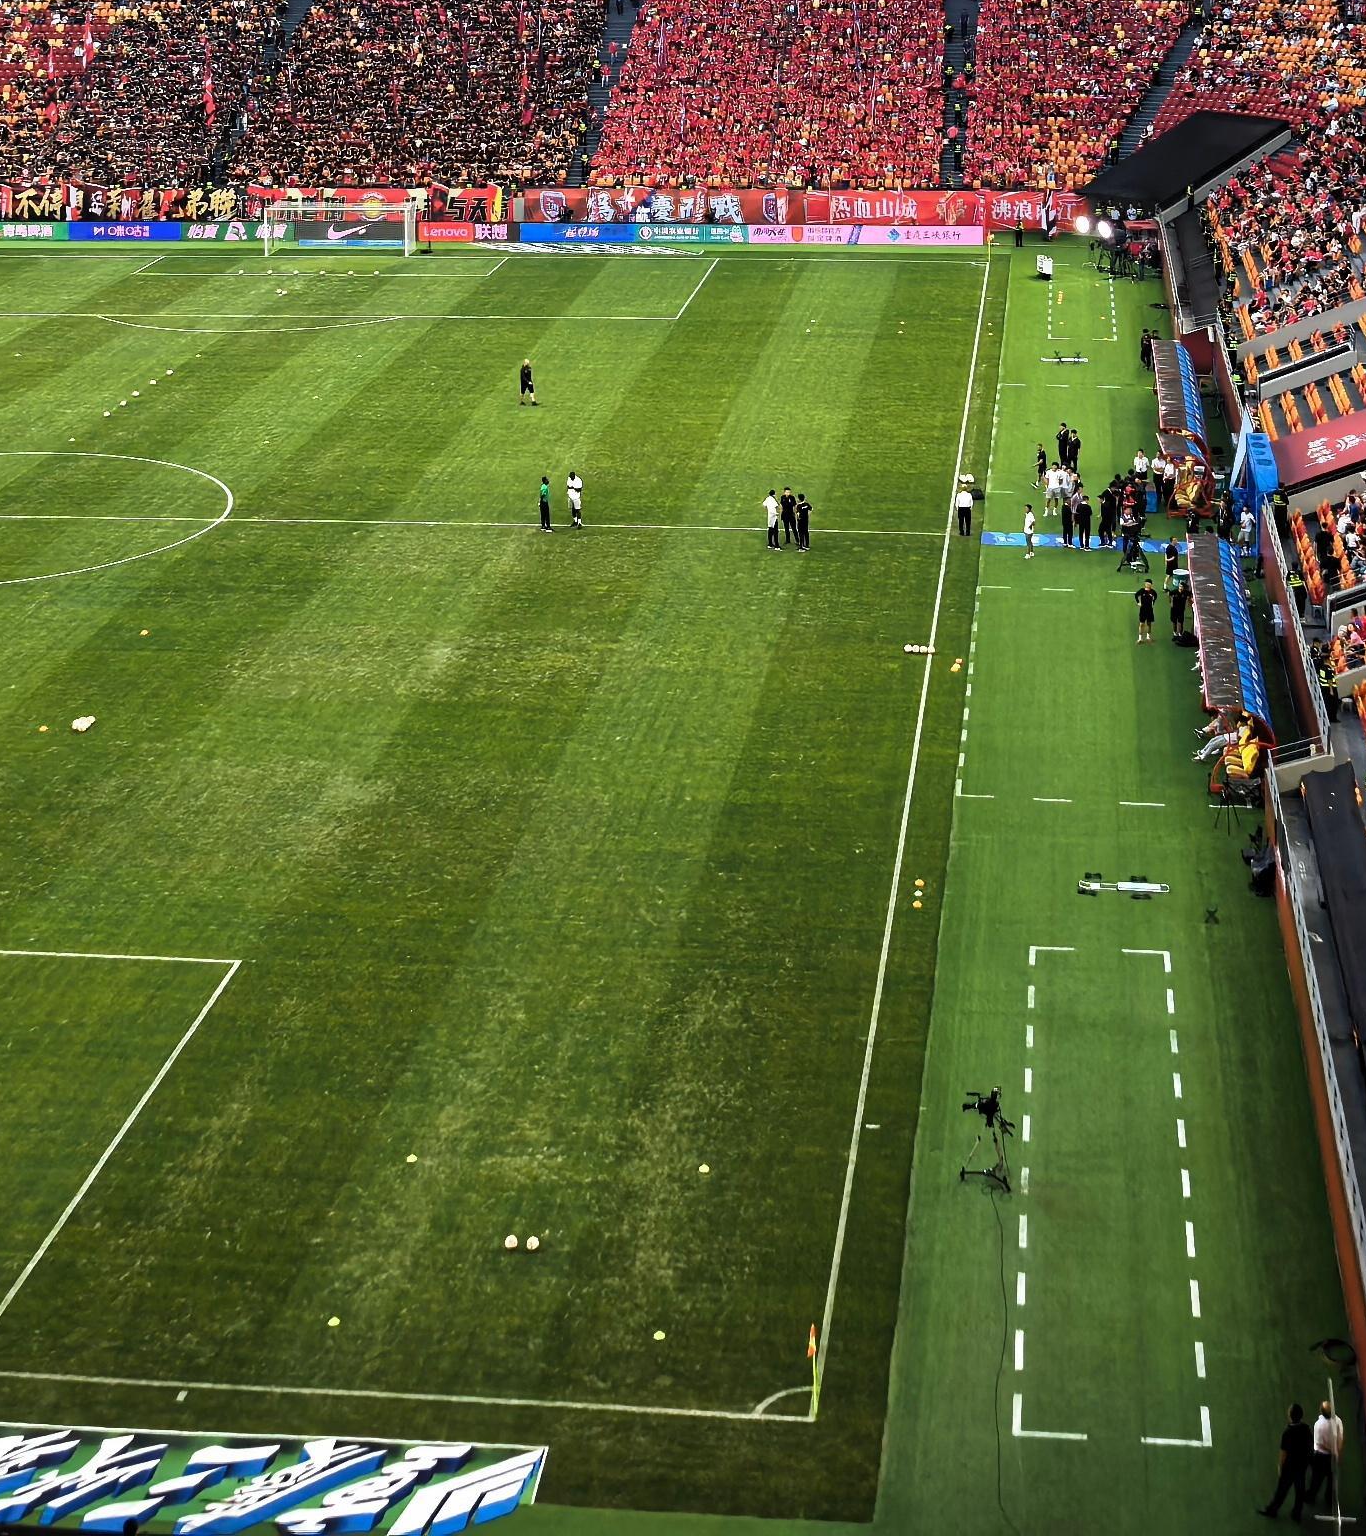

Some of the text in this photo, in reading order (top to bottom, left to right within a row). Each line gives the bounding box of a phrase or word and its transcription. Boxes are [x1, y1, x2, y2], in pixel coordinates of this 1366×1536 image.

[424, 226, 468, 237] Lenovo
[474, 223, 508, 240] 联想
[903, 230, 962, 241] 重庆三峡银行
